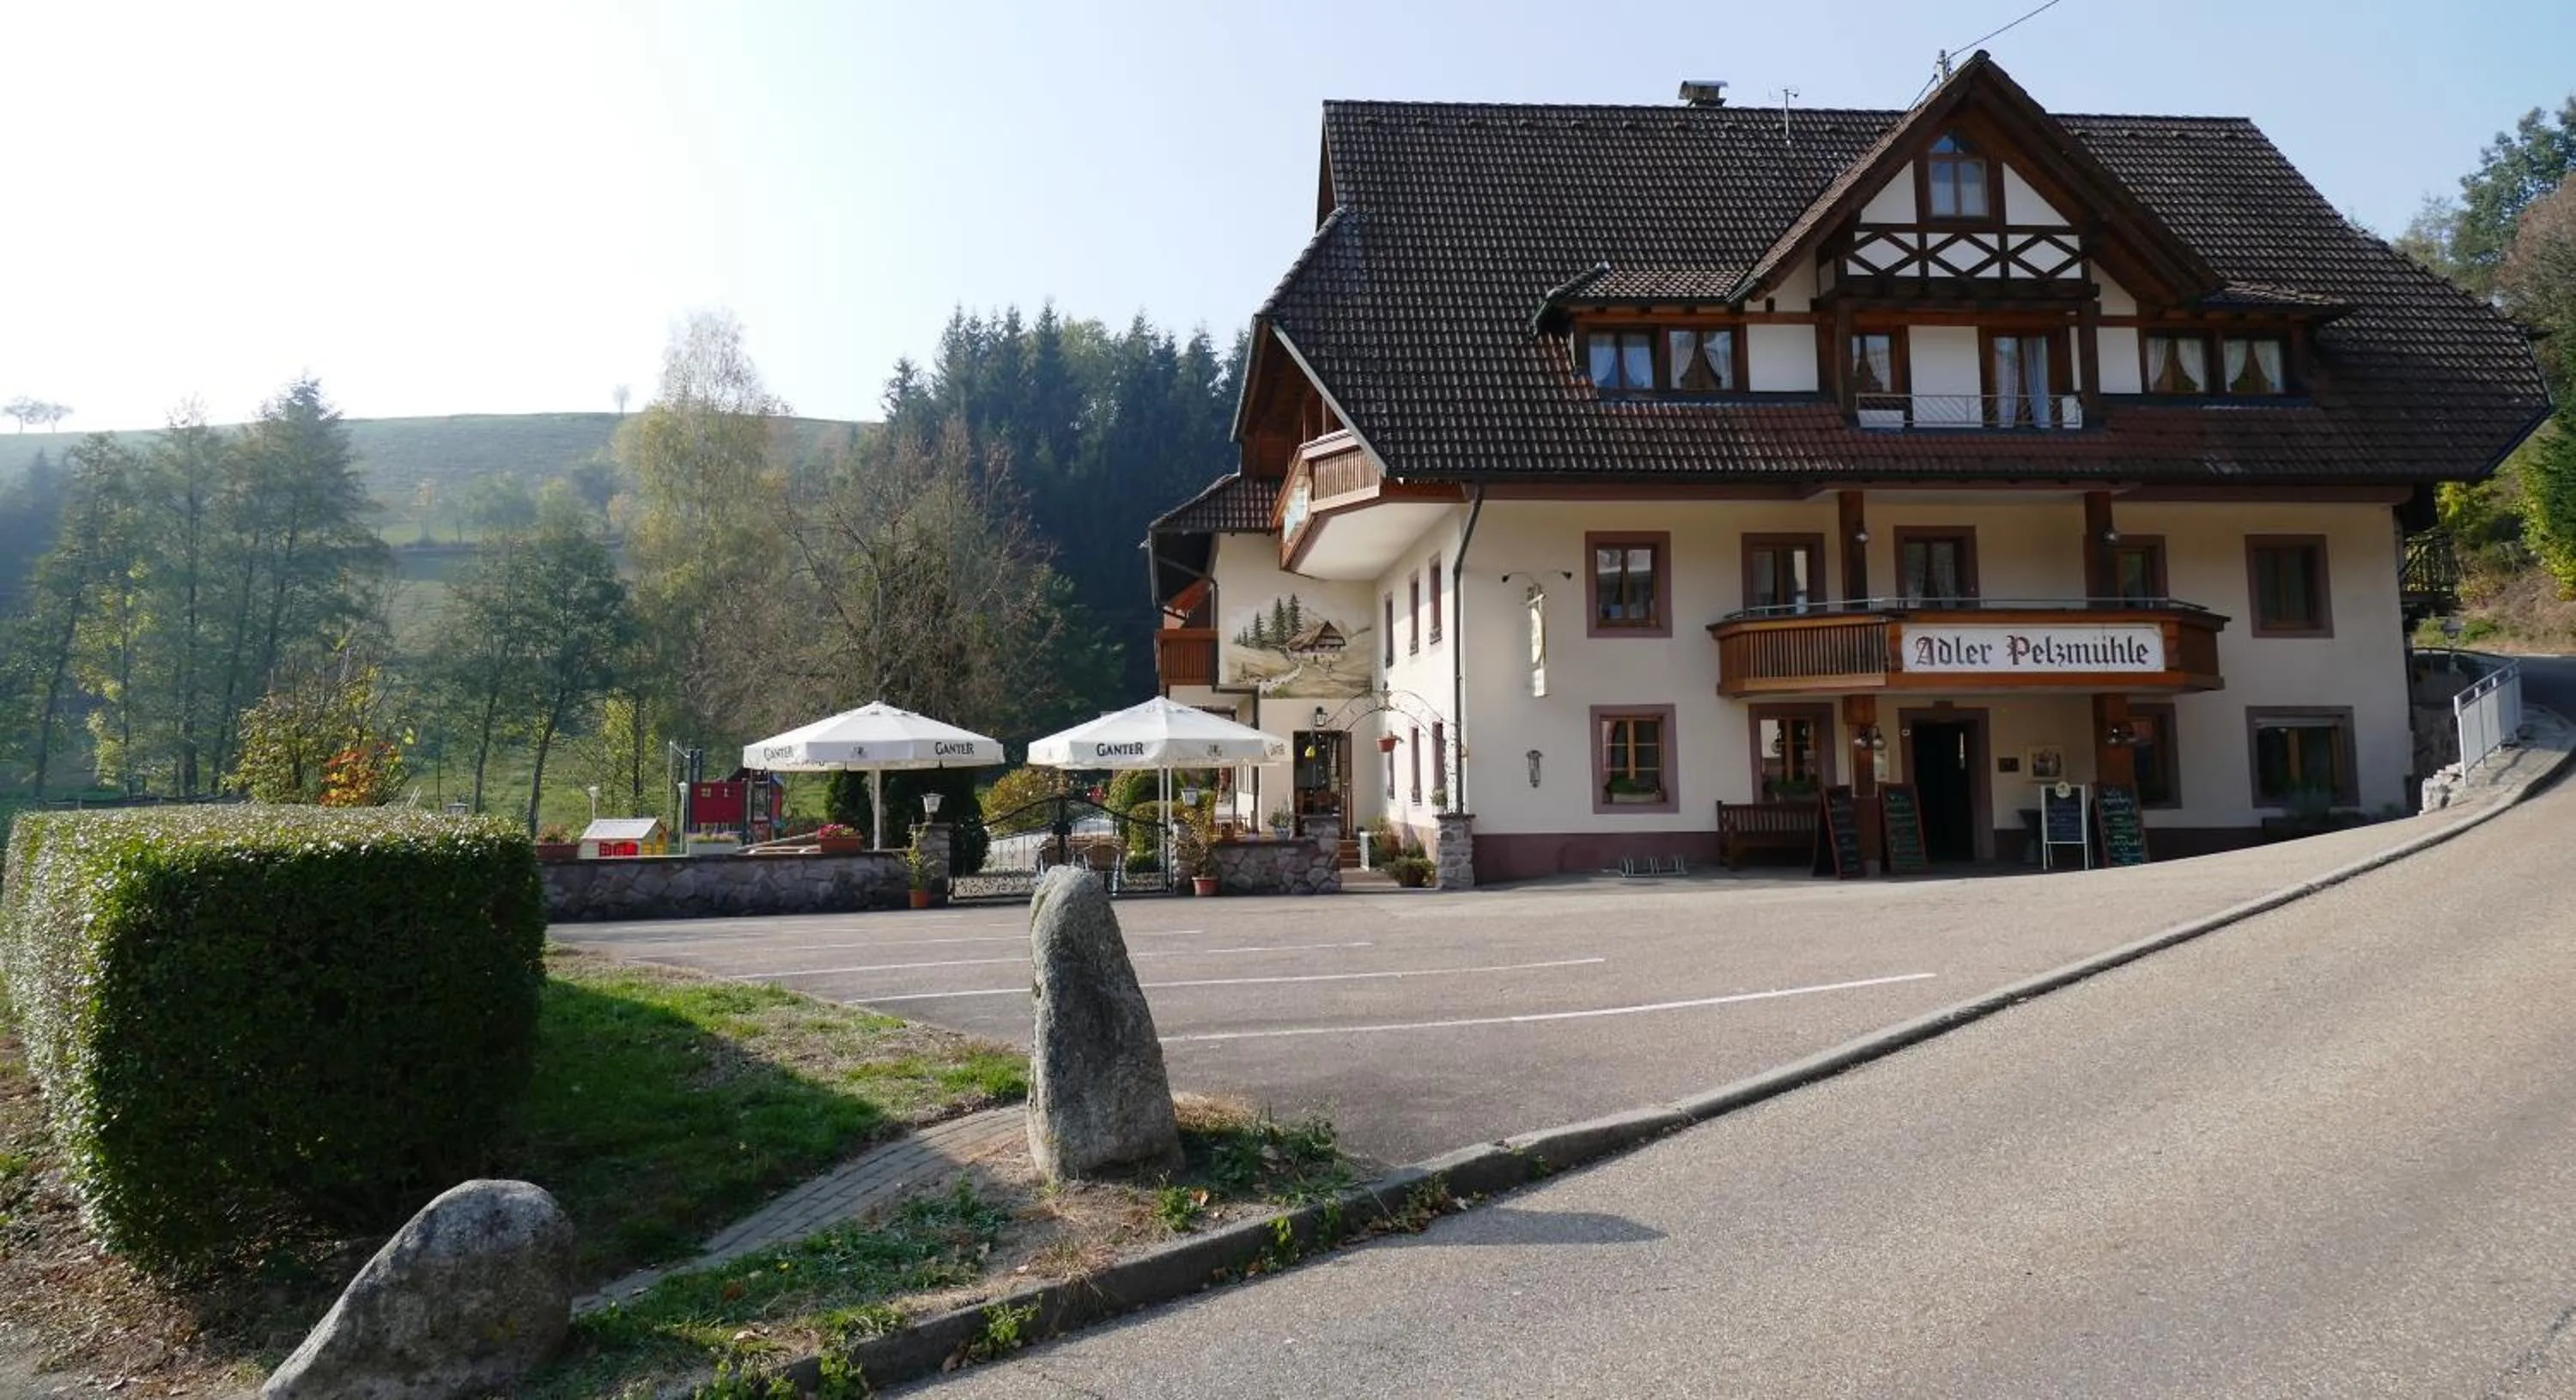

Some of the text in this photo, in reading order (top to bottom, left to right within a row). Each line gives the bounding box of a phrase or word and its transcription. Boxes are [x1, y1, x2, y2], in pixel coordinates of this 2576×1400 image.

[1916, 634, 2149, 667] Adler Pelzmühle
[934, 741, 975, 755] GANTER
[1097, 741, 1145, 757] GANTER
